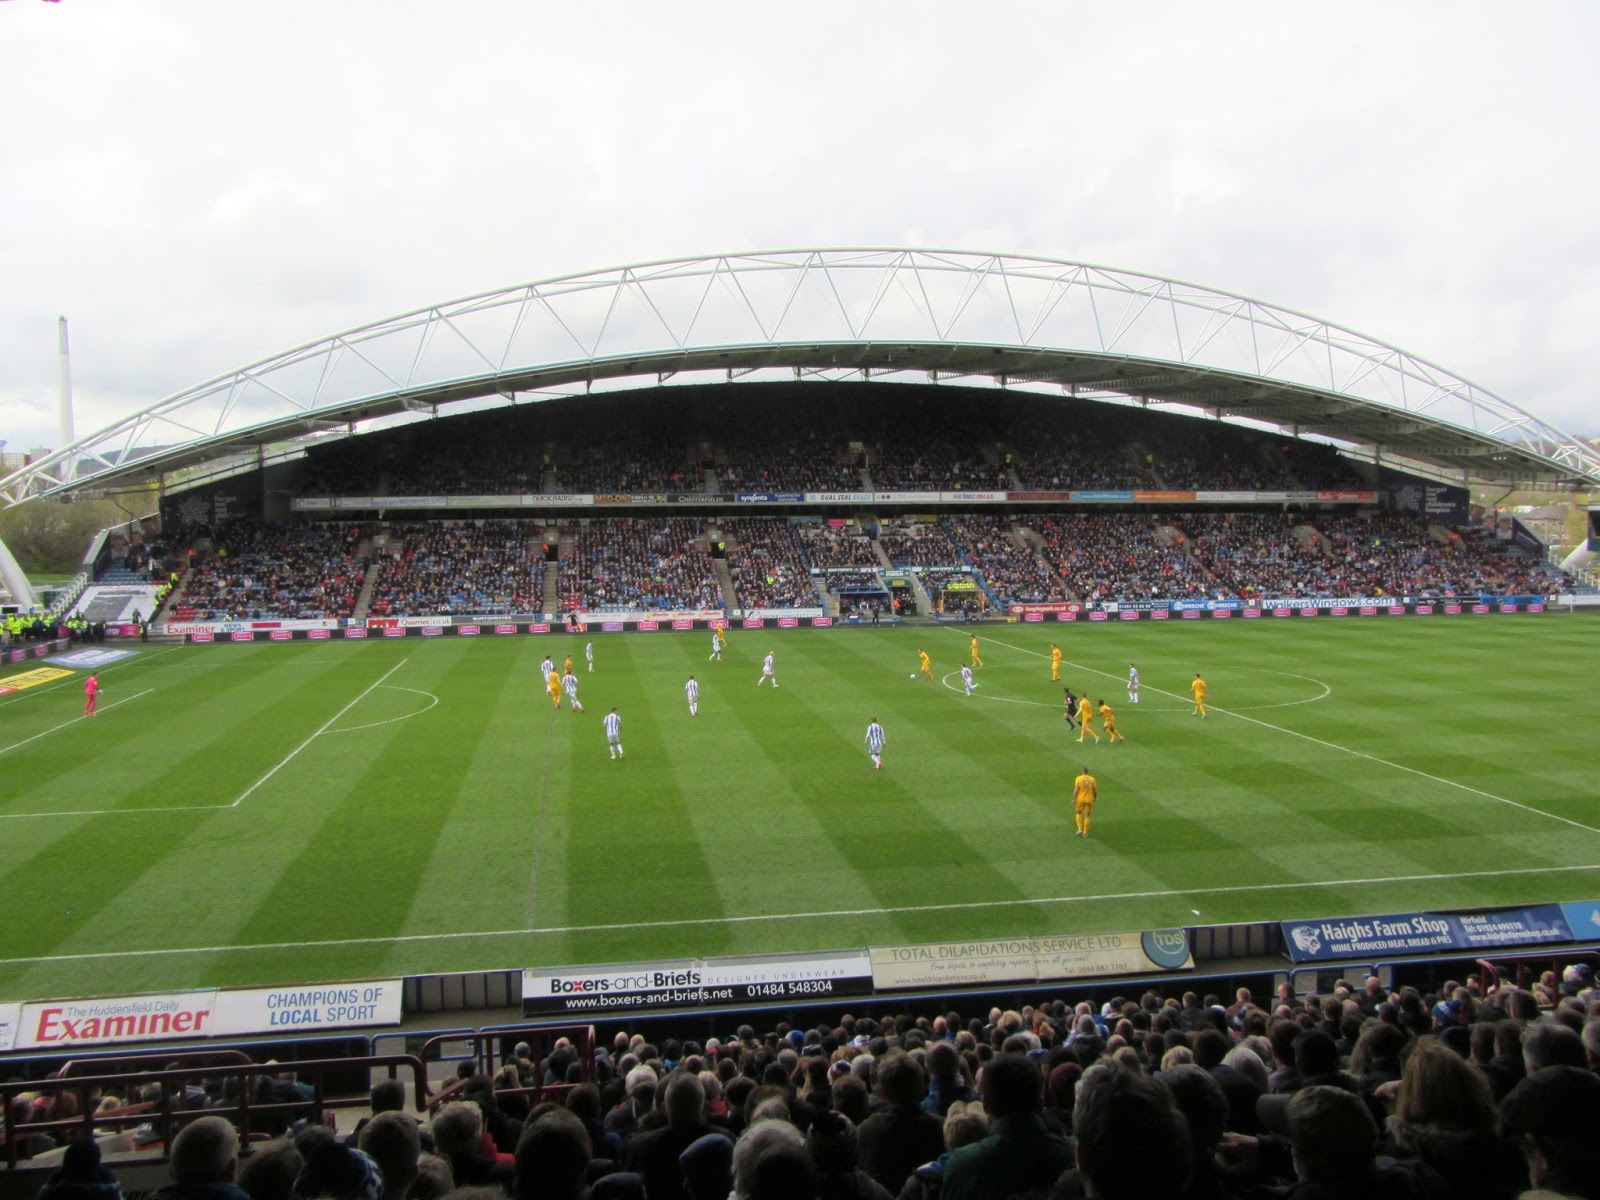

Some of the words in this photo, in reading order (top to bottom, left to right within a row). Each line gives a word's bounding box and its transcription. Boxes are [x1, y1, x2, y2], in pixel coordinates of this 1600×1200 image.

[741, 493, 768, 503] syngenta
[166, 624, 215, 634] Examiner
[1321, 922, 1374, 942] Haighs
[1372, 920, 1410, 936] Farm
[1411, 917, 1450, 935] Shop
[1156, 933, 1183, 946] TDS
[1331, 944, 1352, 952] HOME
[1352, 941, 1388, 951] PRODUCED
[1388, 938, 1408, 948] MEAT,
[1408, 938, 1430, 947] BREAD
[1437, 936, 1452, 944] PIES
[891, 948, 936, 961] TOTAL
[940, 942, 1041, 958] DILAPIDATIONS
[1043, 938, 1096, 951] SERVICE
[1100, 936, 1122, 948] LTD
[930, 962, 945, 970] From
[551, 970, 701, 994] Boxers-and-Briefs
[708, 974, 766, 984] DESIGNER
[774, 969, 846, 980] UNDERWEAR
[895, 972, 987, 984] www.totaldilapidations.co.uk
[267, 988, 358, 1009] CHAMPIONS
[363, 987, 383, 1002] OF
[566, 988, 733, 1008] www.boxers-and-briefs.net
[747, 984, 786, 997] 01484
[788, 980, 833, 994] 548304
[67, 1007, 86, 1017] The
[89, 1002, 152, 1016] Huddersfield
[154, 1000, 180, 1013] Daily
[270, 1008, 322, 1026] LOCAL
[326, 1005, 377, 1022] SPORT
[35, 1008, 210, 1042] Examiner
